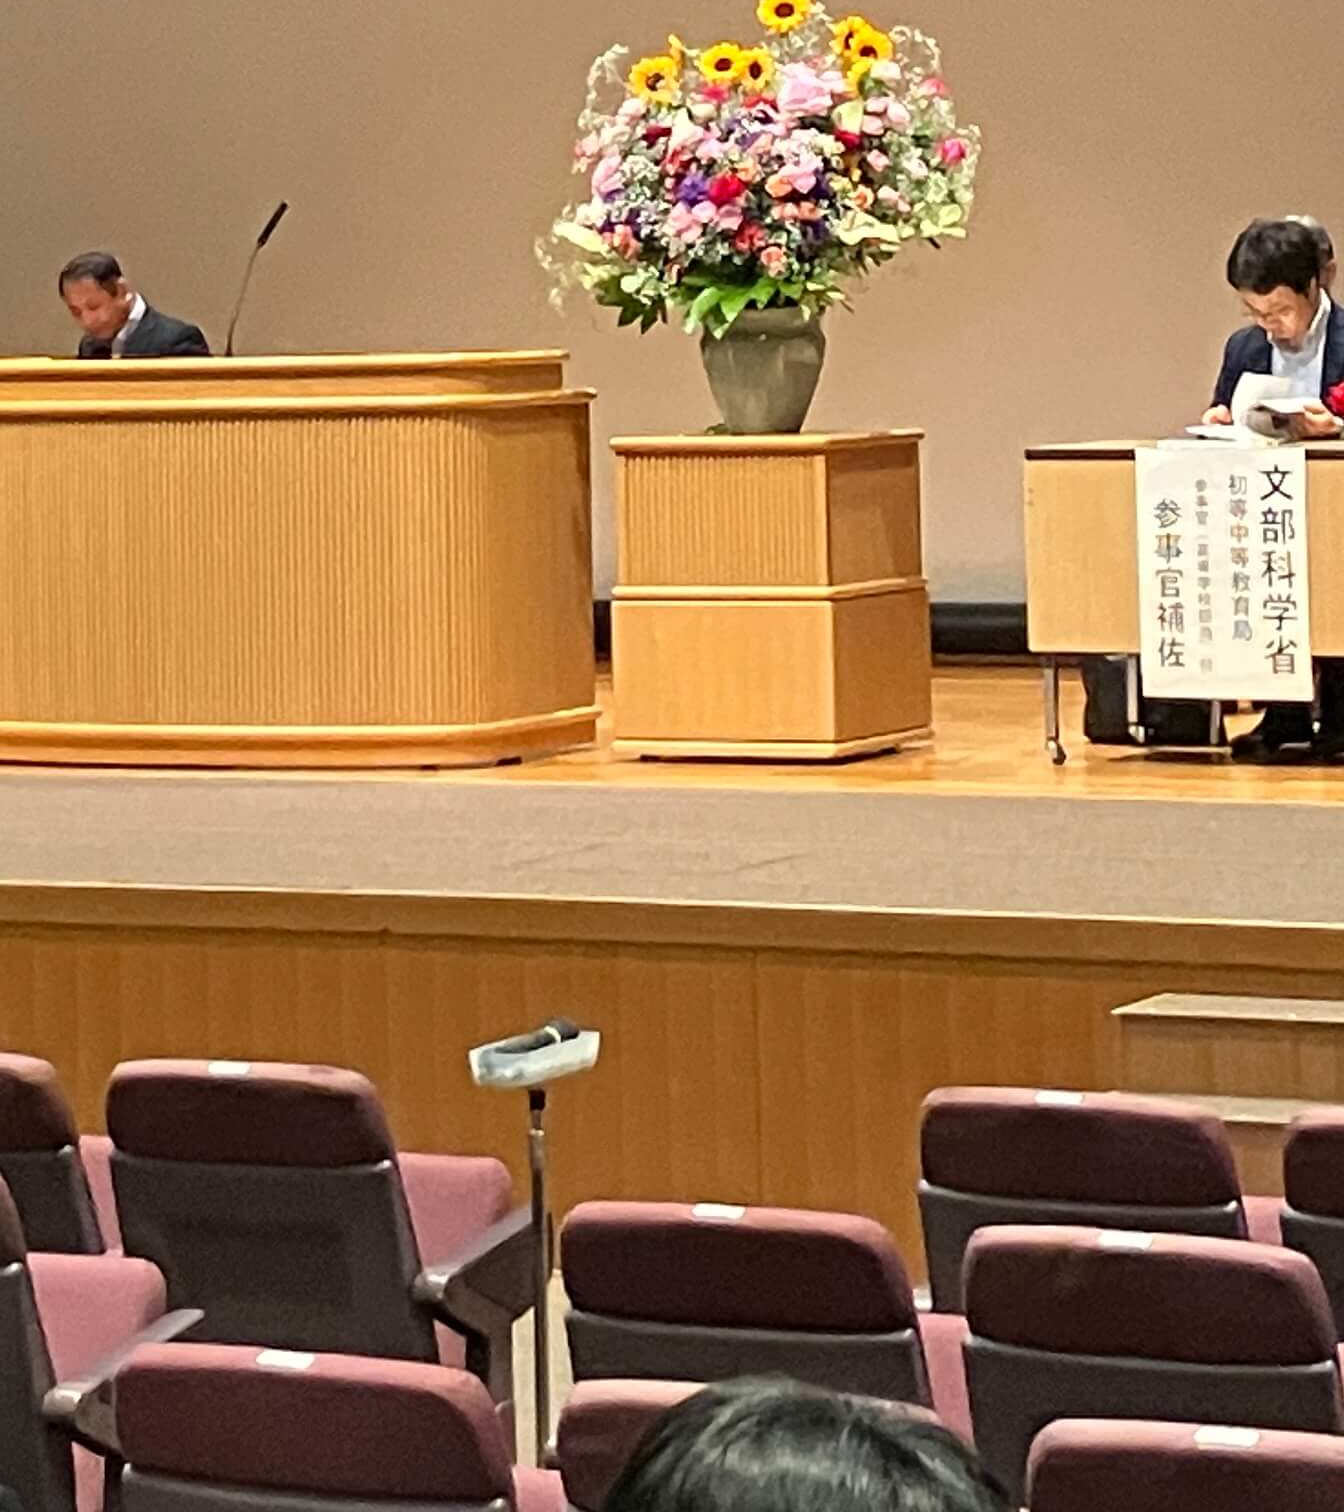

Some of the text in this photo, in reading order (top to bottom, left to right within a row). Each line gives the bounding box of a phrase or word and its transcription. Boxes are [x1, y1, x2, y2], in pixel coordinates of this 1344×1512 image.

[1154, 498, 1186, 669] 参事官補佐
[1259, 464, 1298, 675] 文部科学省
